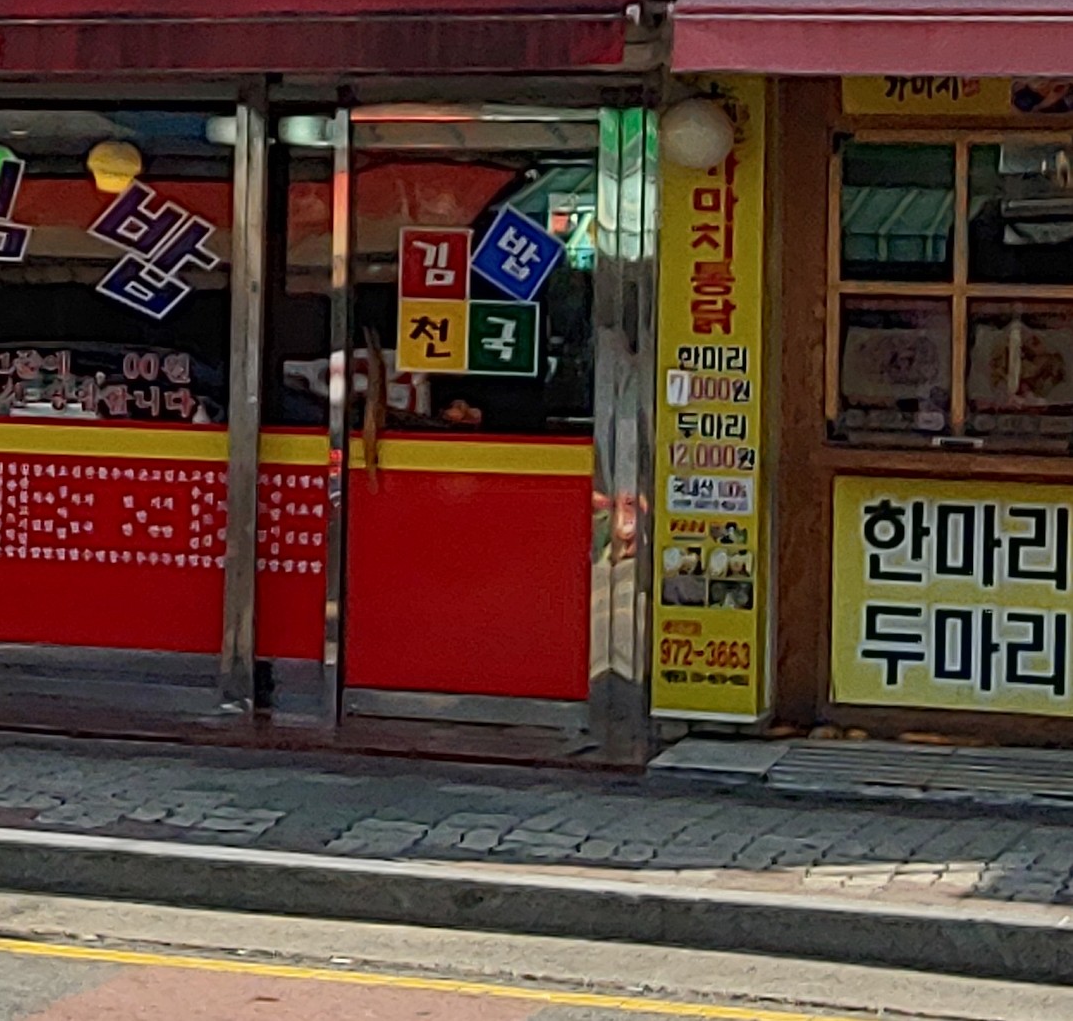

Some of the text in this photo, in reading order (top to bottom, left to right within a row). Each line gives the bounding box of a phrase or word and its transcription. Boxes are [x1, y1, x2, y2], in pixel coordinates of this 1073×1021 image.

[691, 150, 740, 335] 마치통닭
[863, 498, 1069, 592] 한마리
[860, 604, 1068, 697] 두마리
